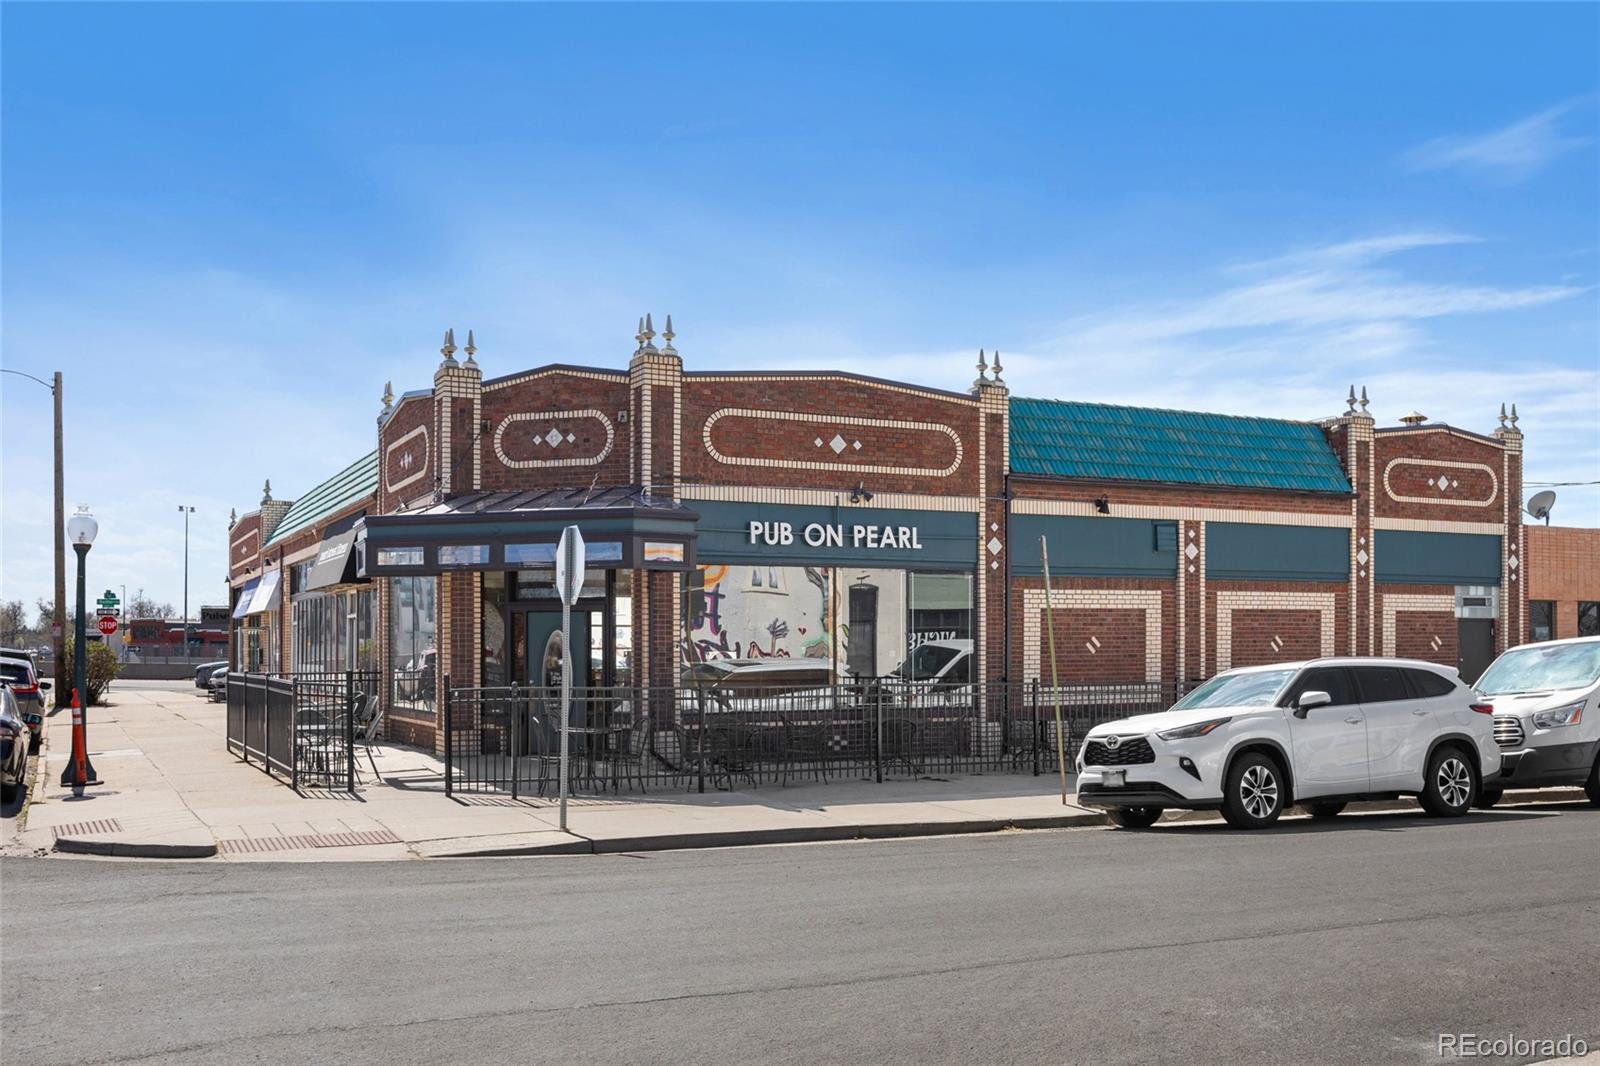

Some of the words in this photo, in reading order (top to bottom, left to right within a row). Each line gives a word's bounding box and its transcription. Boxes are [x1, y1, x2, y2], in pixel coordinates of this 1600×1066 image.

[750, 520, 794, 546] PUB
[804, 522, 843, 547] ON
[853, 524, 923, 549] PEARL
[99, 621, 117, 630] STOP
